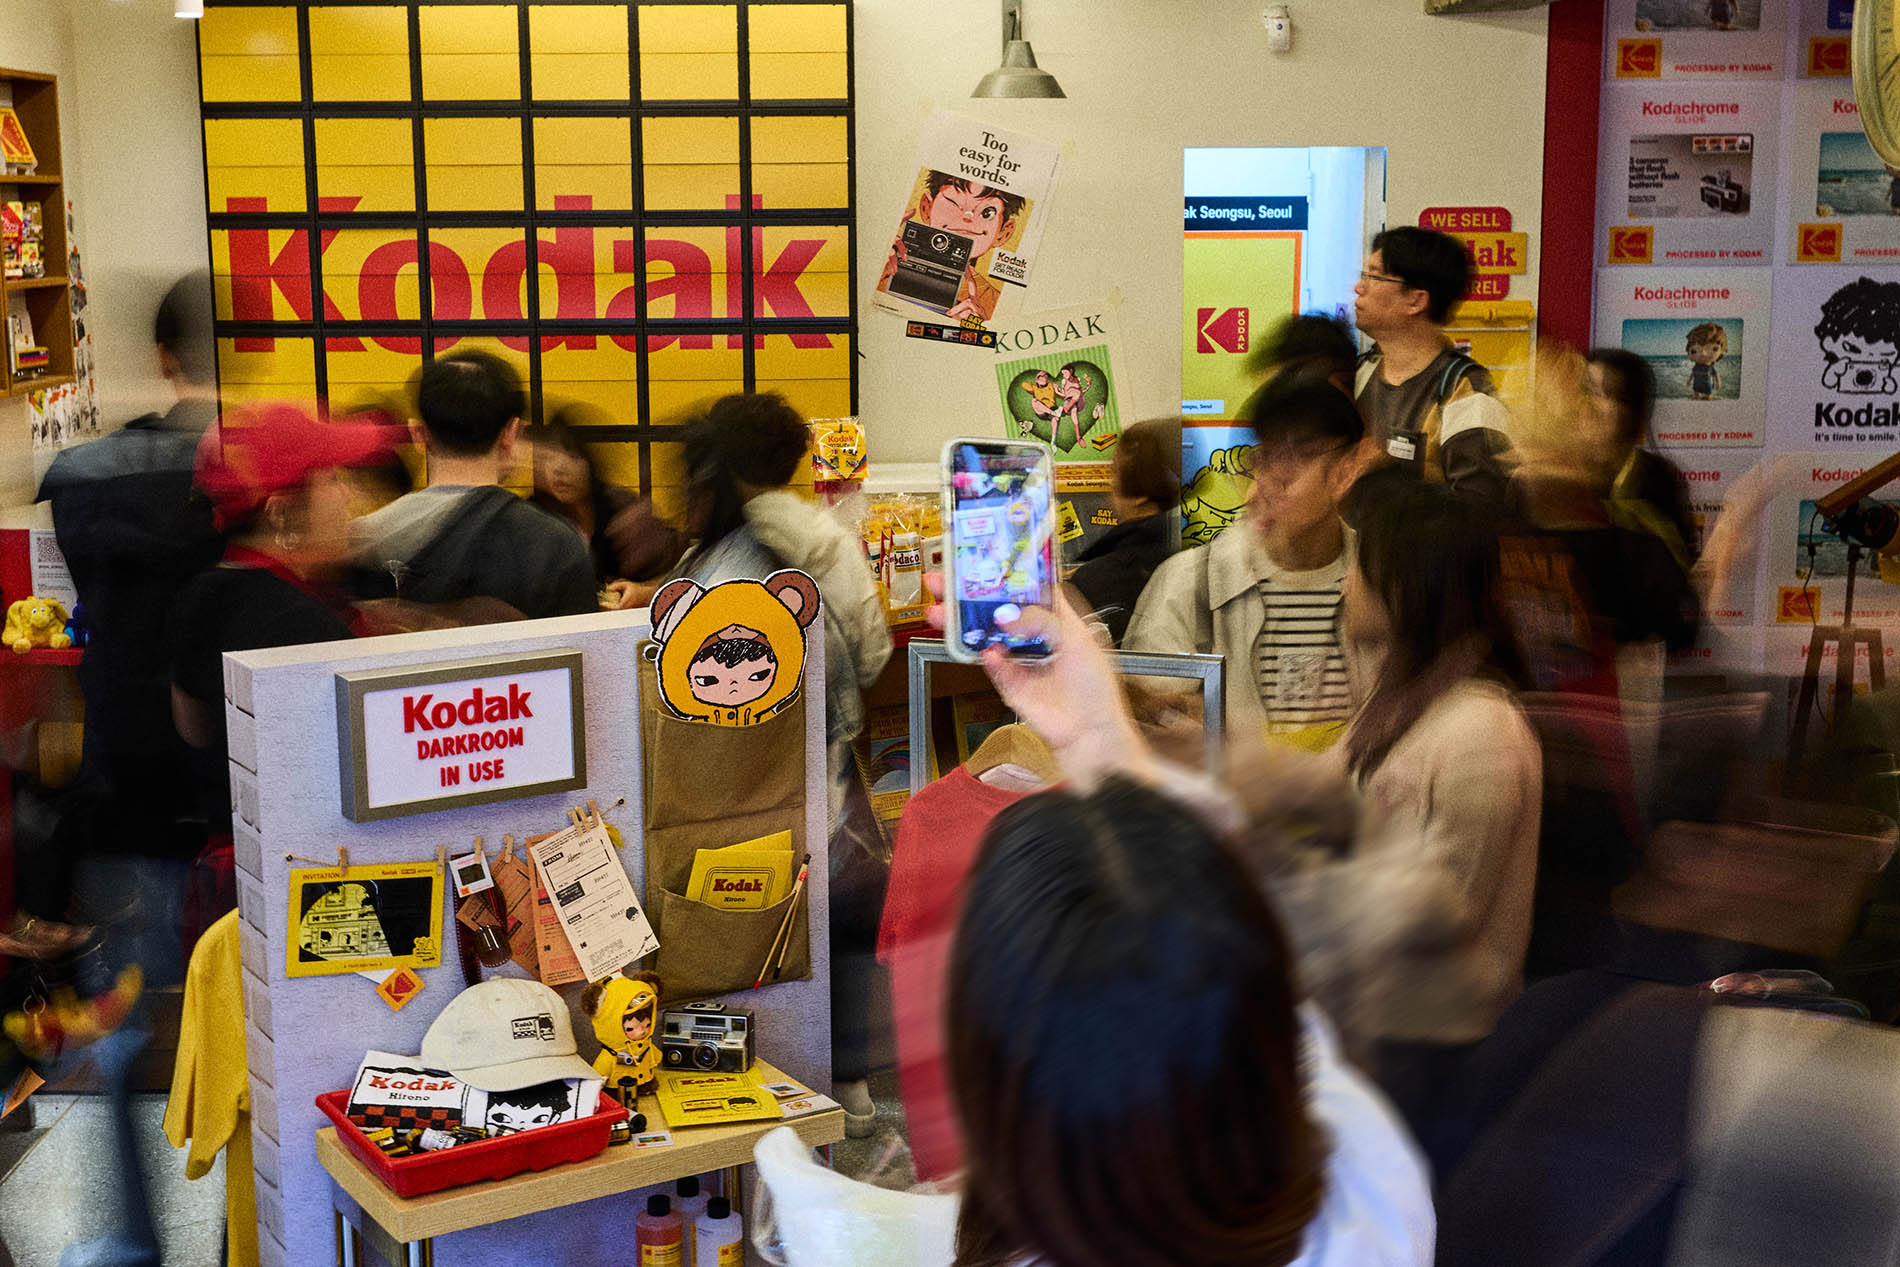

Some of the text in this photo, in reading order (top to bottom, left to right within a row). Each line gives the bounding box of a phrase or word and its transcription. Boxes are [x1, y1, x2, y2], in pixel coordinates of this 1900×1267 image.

[1674, 64, 1726, 72] PROCESSED
[1642, 101, 1739, 116] Kodachrome
[1674, 115, 1707, 124] SLIDE
[982, 131, 1008, 153] Too
[959, 146, 1022, 172] easy for
[959, 162, 1010, 187] words.
[1629, 171, 1680, 181] without flash
[1200, 205, 1256, 222] Seongsu,
[1259, 205, 1292, 219] Seoul
[1430, 213, 1501, 227] WE SELL
[997, 252, 1028, 268] Kodak
[1665, 249, 1763, 259] PROCESSED BY KODAK
[226, 194, 834, 354] Kodak
[1005, 270, 1024, 279] COLOR
[1634, 285, 1730, 300] Kodachrome
[968, 315, 984, 324] SAY
[994, 314, 1106, 354] KODAK
[1237, 310, 1246, 351] KODAK
[1814, 402, 1900, 428] Kodak
[827, 435, 855, 443] Kodak
[1658, 431, 1753, 440] PROCESSED BY KODAK
[1815, 432, 1897, 441] It's time to smile.
[1097, 509, 1113, 517] SAY
[1091, 516, 1118, 526] KODAK
[403, 683, 533, 733] Kodak
[417, 727, 524, 760] DARKROOM
[440, 759, 504, 787] IN USE
[712, 878, 763, 892] Kodak
[368, 1075, 457, 1091] Kodak
[680, 1077, 737, 1085] Kodak
[388, 1092, 430, 1101] Hirono
